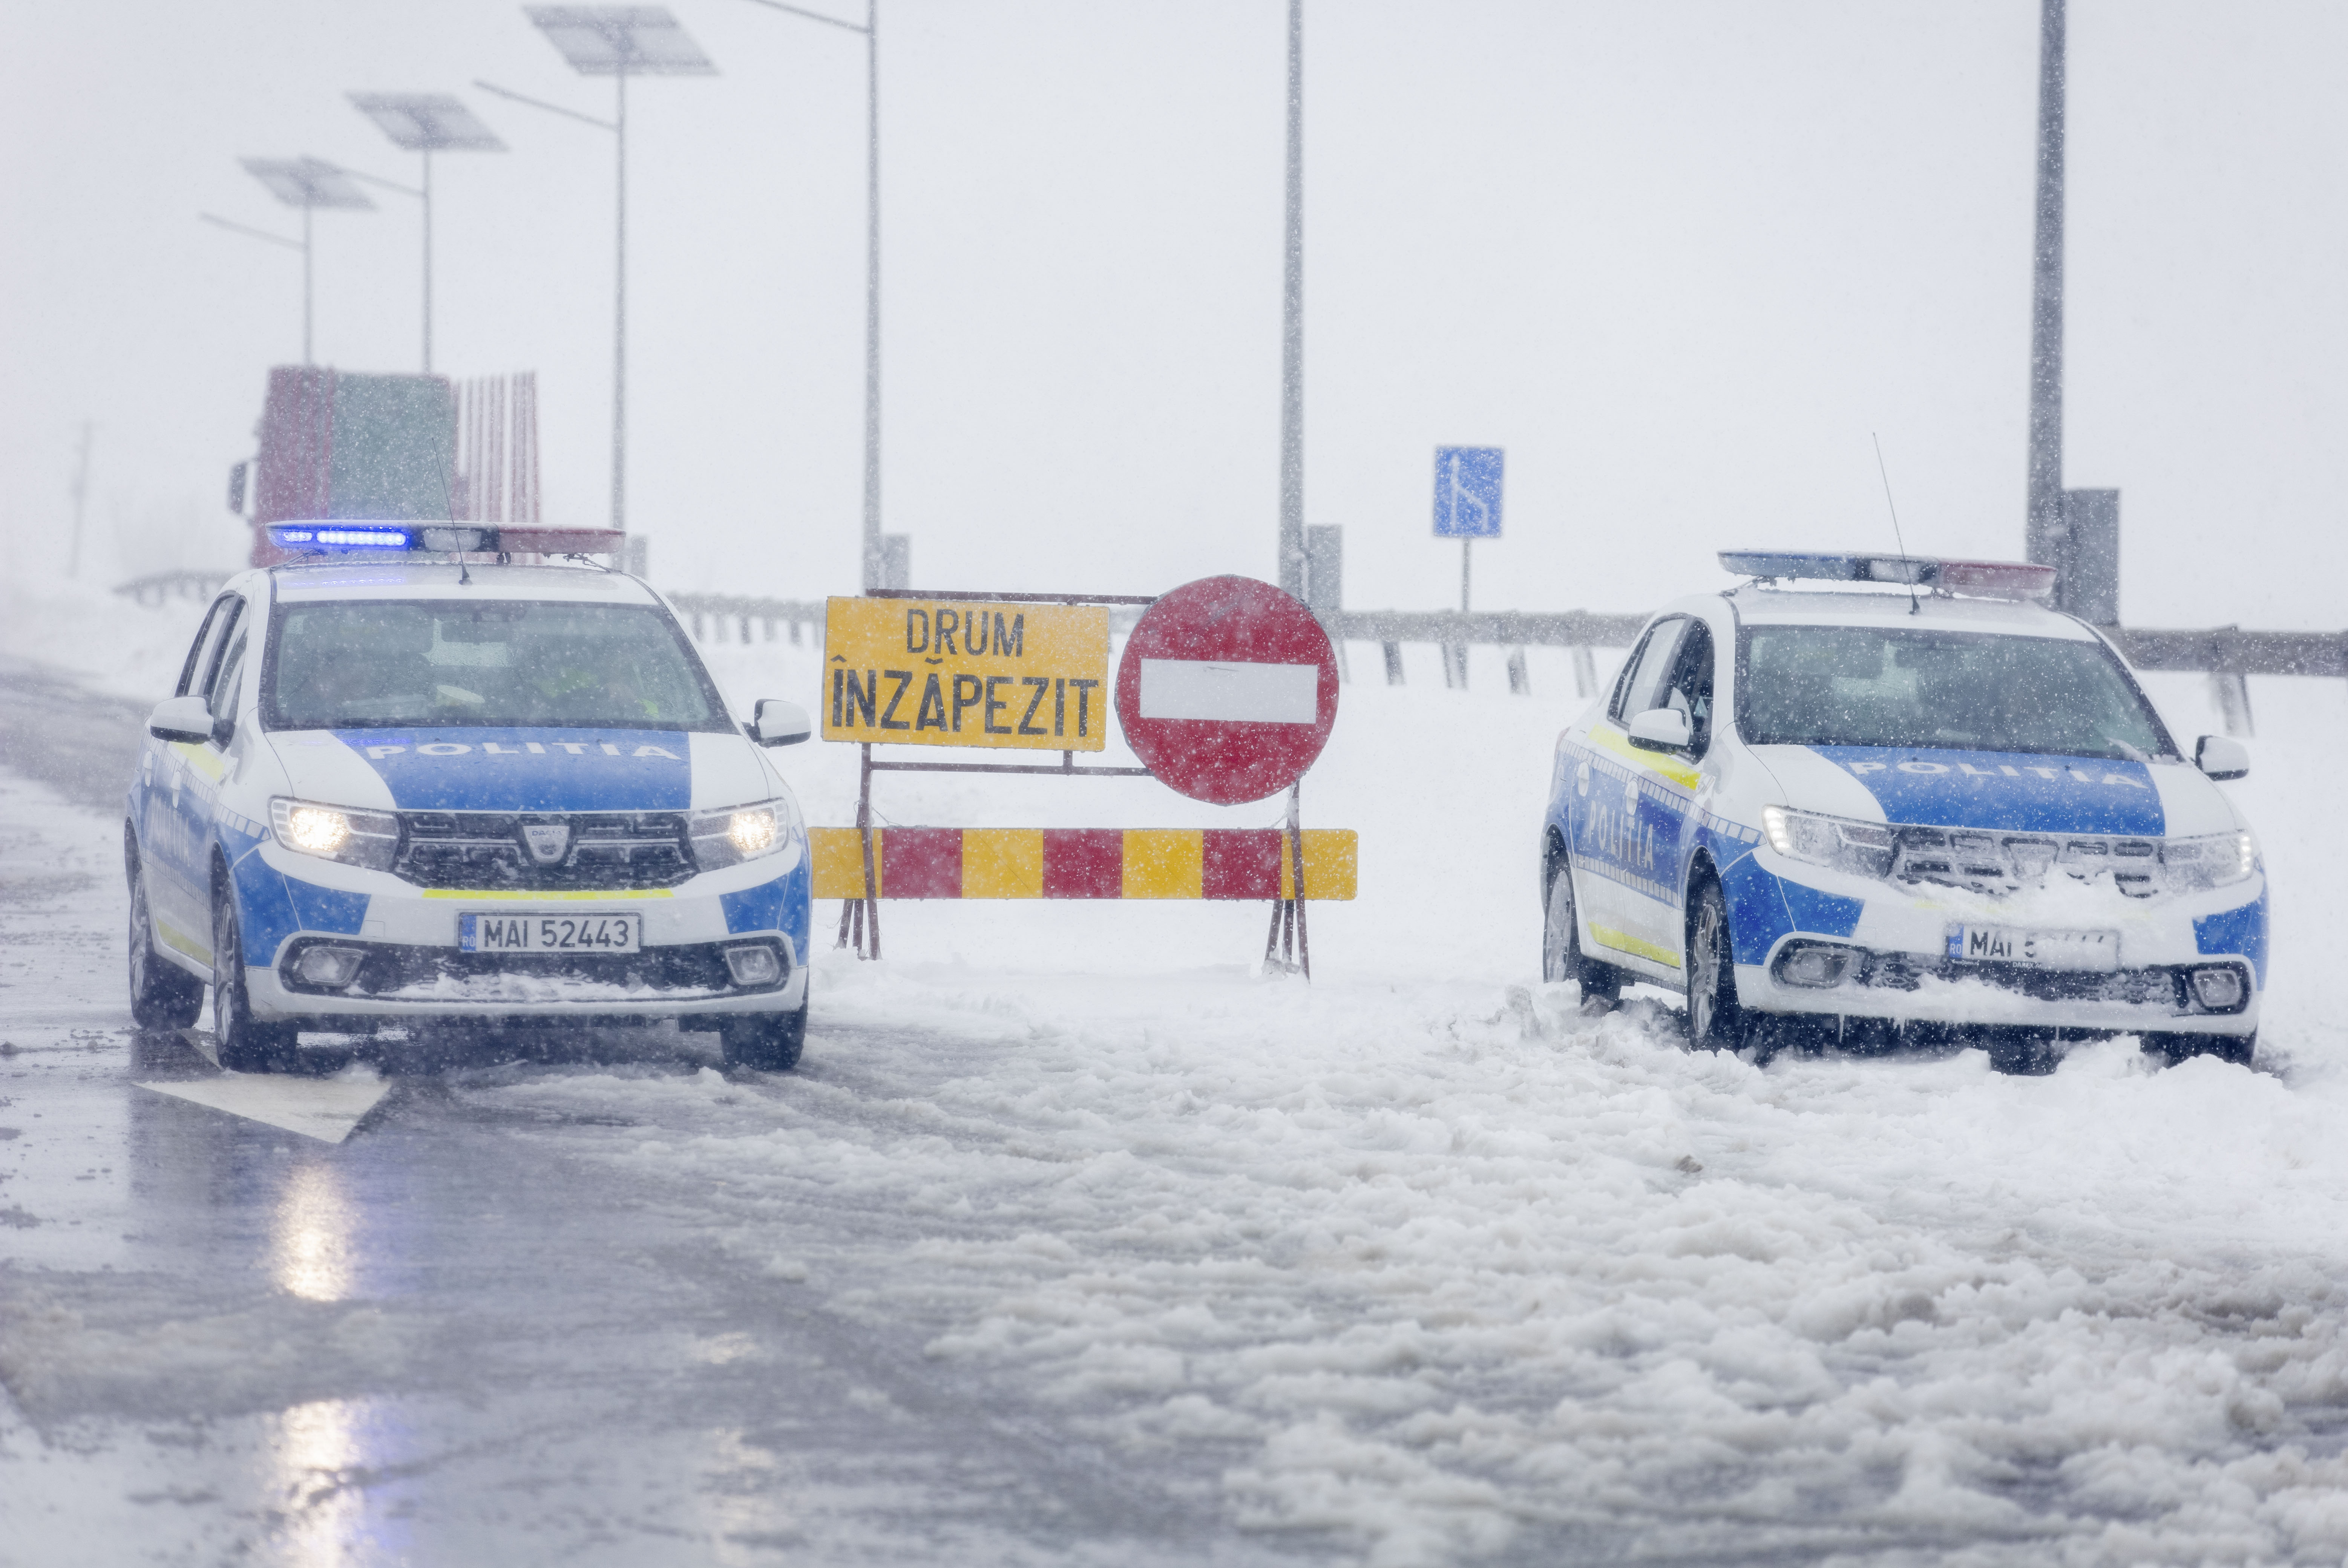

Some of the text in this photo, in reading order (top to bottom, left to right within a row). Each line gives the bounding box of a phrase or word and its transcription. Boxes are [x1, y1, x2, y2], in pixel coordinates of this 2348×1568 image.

[907, 608, 1024, 658] DRUM
[831, 654, 1099, 737] ÎNZĂPEZIT
[366, 742, 682, 760] POLITIA
[1848, 762, 2149, 789] POLITIA
[1588, 800, 1654, 871] POLITIA
[463, 936, 476, 947] RO
[484, 920, 628, 948] MAI 52443
[1970, 930, 2011, 957] MAI
[1950, 943, 1962, 954] RO
